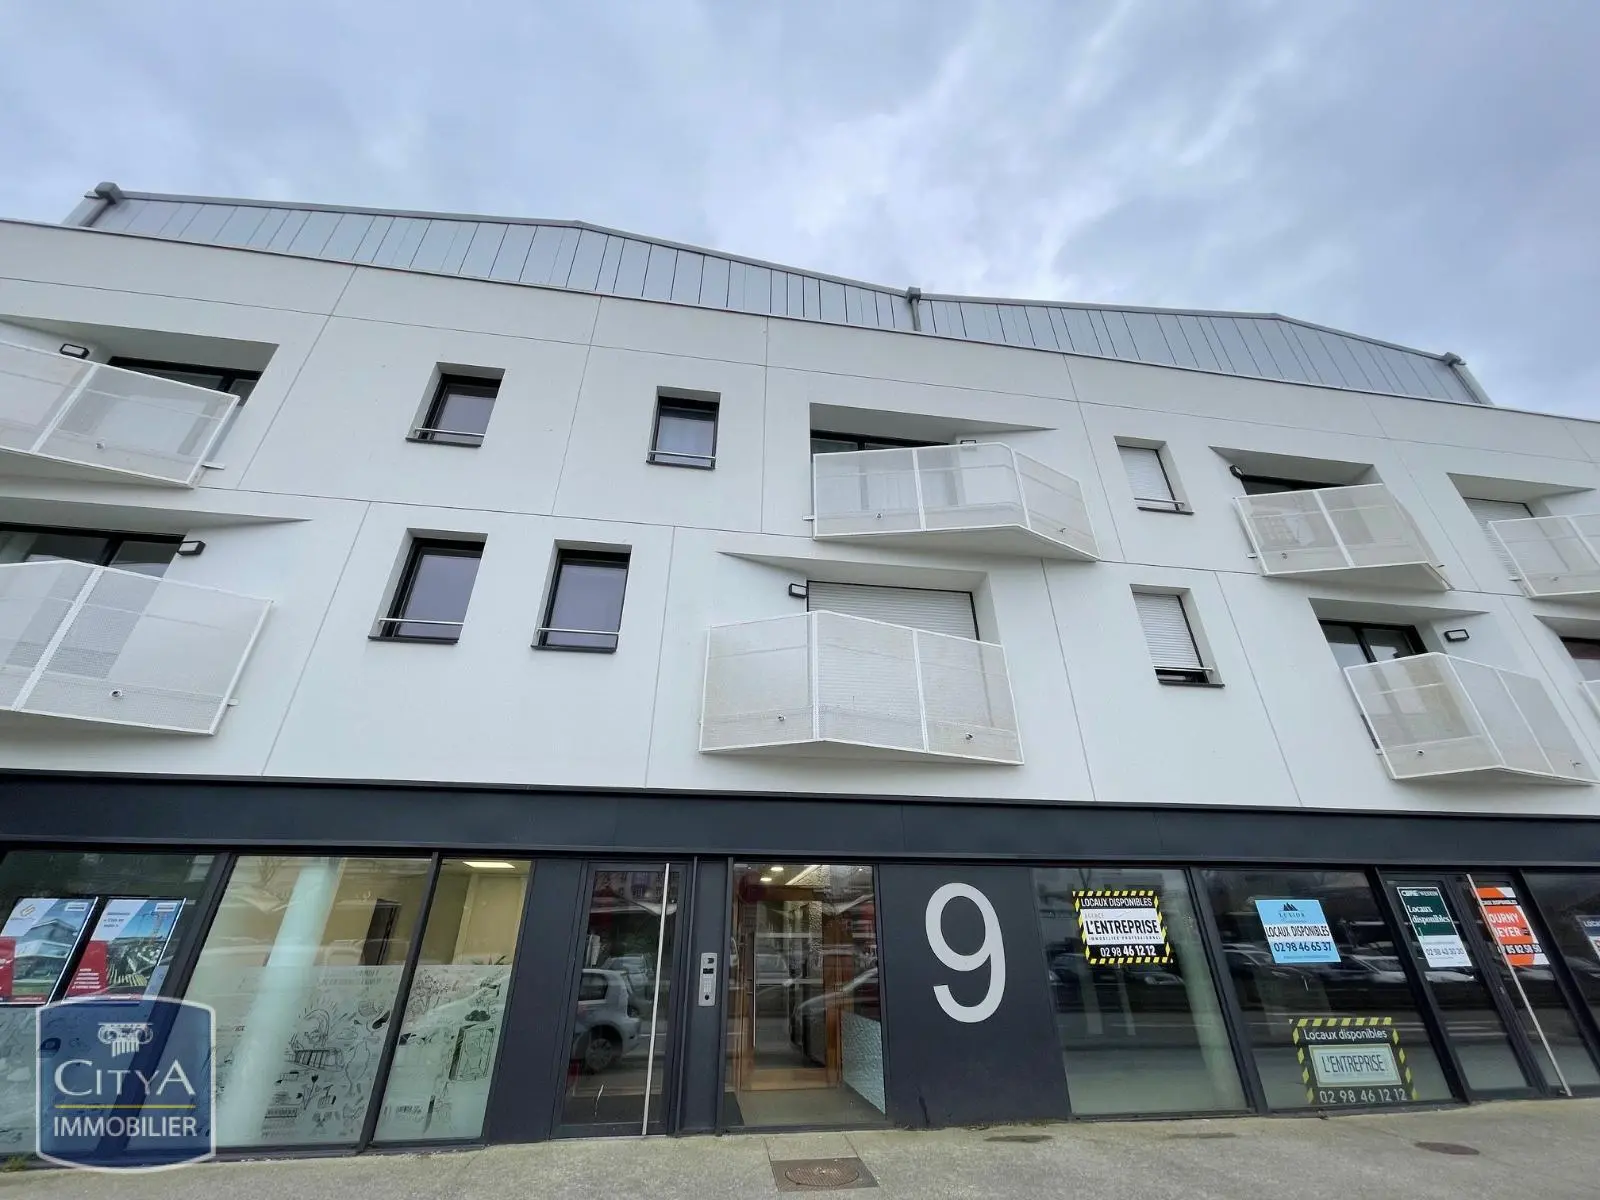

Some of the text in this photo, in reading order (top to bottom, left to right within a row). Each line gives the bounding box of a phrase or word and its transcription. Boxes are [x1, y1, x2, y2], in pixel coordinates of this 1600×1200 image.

[1081, 897, 1152, 907] LOCAUX DISPONIBLES
[1407, 905, 1433, 913] Locaux
[1412, 915, 1452, 925] disponibles
[1488, 912, 1519, 923] OURNY
[1086, 920, 1159, 934] L'ENTREPRISE
[1265, 925, 1331, 937] LOCAUX DISPONIBLES
[925, 882, 1006, 1023] 9
[1101, 945, 1156, 957] 02 98 46 12 12
[1274, 942, 1332, 952] 02 98 46 65 37
[1303, 1028, 1388, 1042] Locaux disponibles
[1321, 1054, 1385, 1073] L'ENTREPRISE
[1320, 1088, 1408, 1103] 02 98 46 12 12
